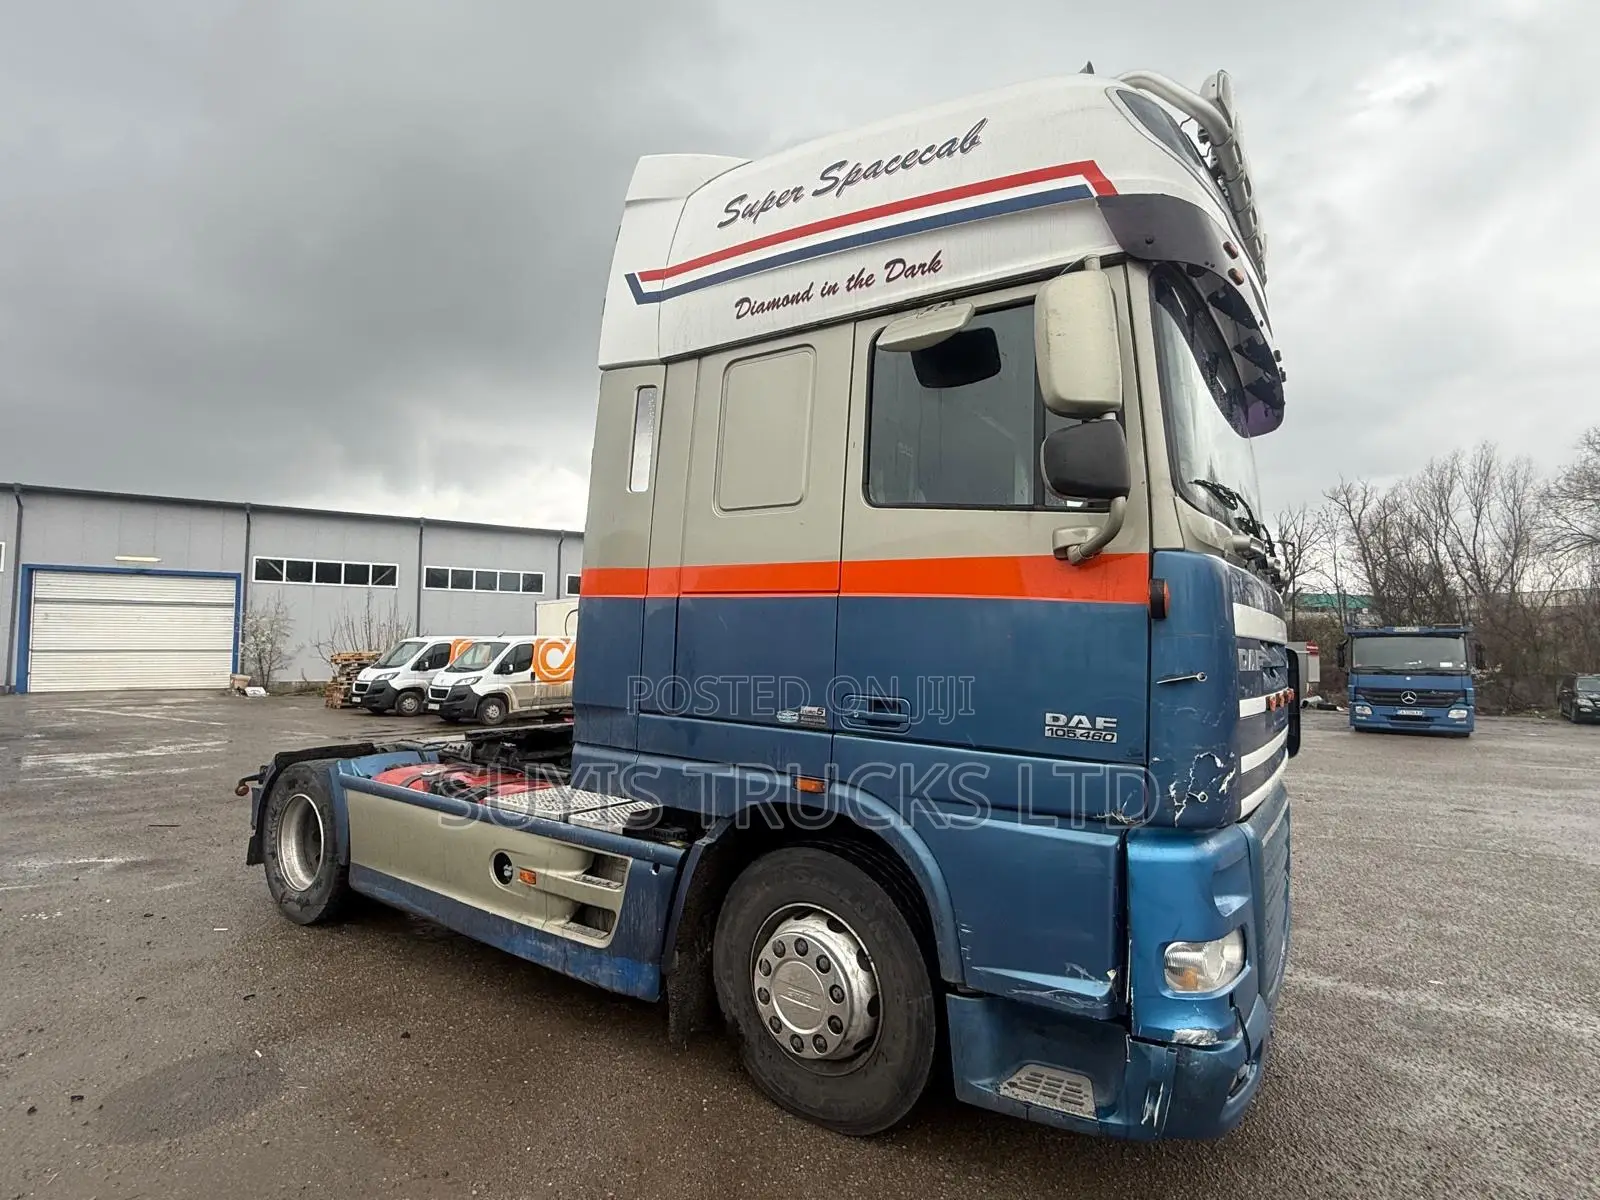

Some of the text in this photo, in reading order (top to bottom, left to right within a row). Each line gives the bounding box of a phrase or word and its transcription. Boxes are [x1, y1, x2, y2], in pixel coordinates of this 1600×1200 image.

[717, 117, 988, 229] Super Spacecab
[734, 249, 943, 320] Diamond in the Dark
[1045, 712, 1118, 730] DAF
[1045, 726, 1117, 743] 105.460
